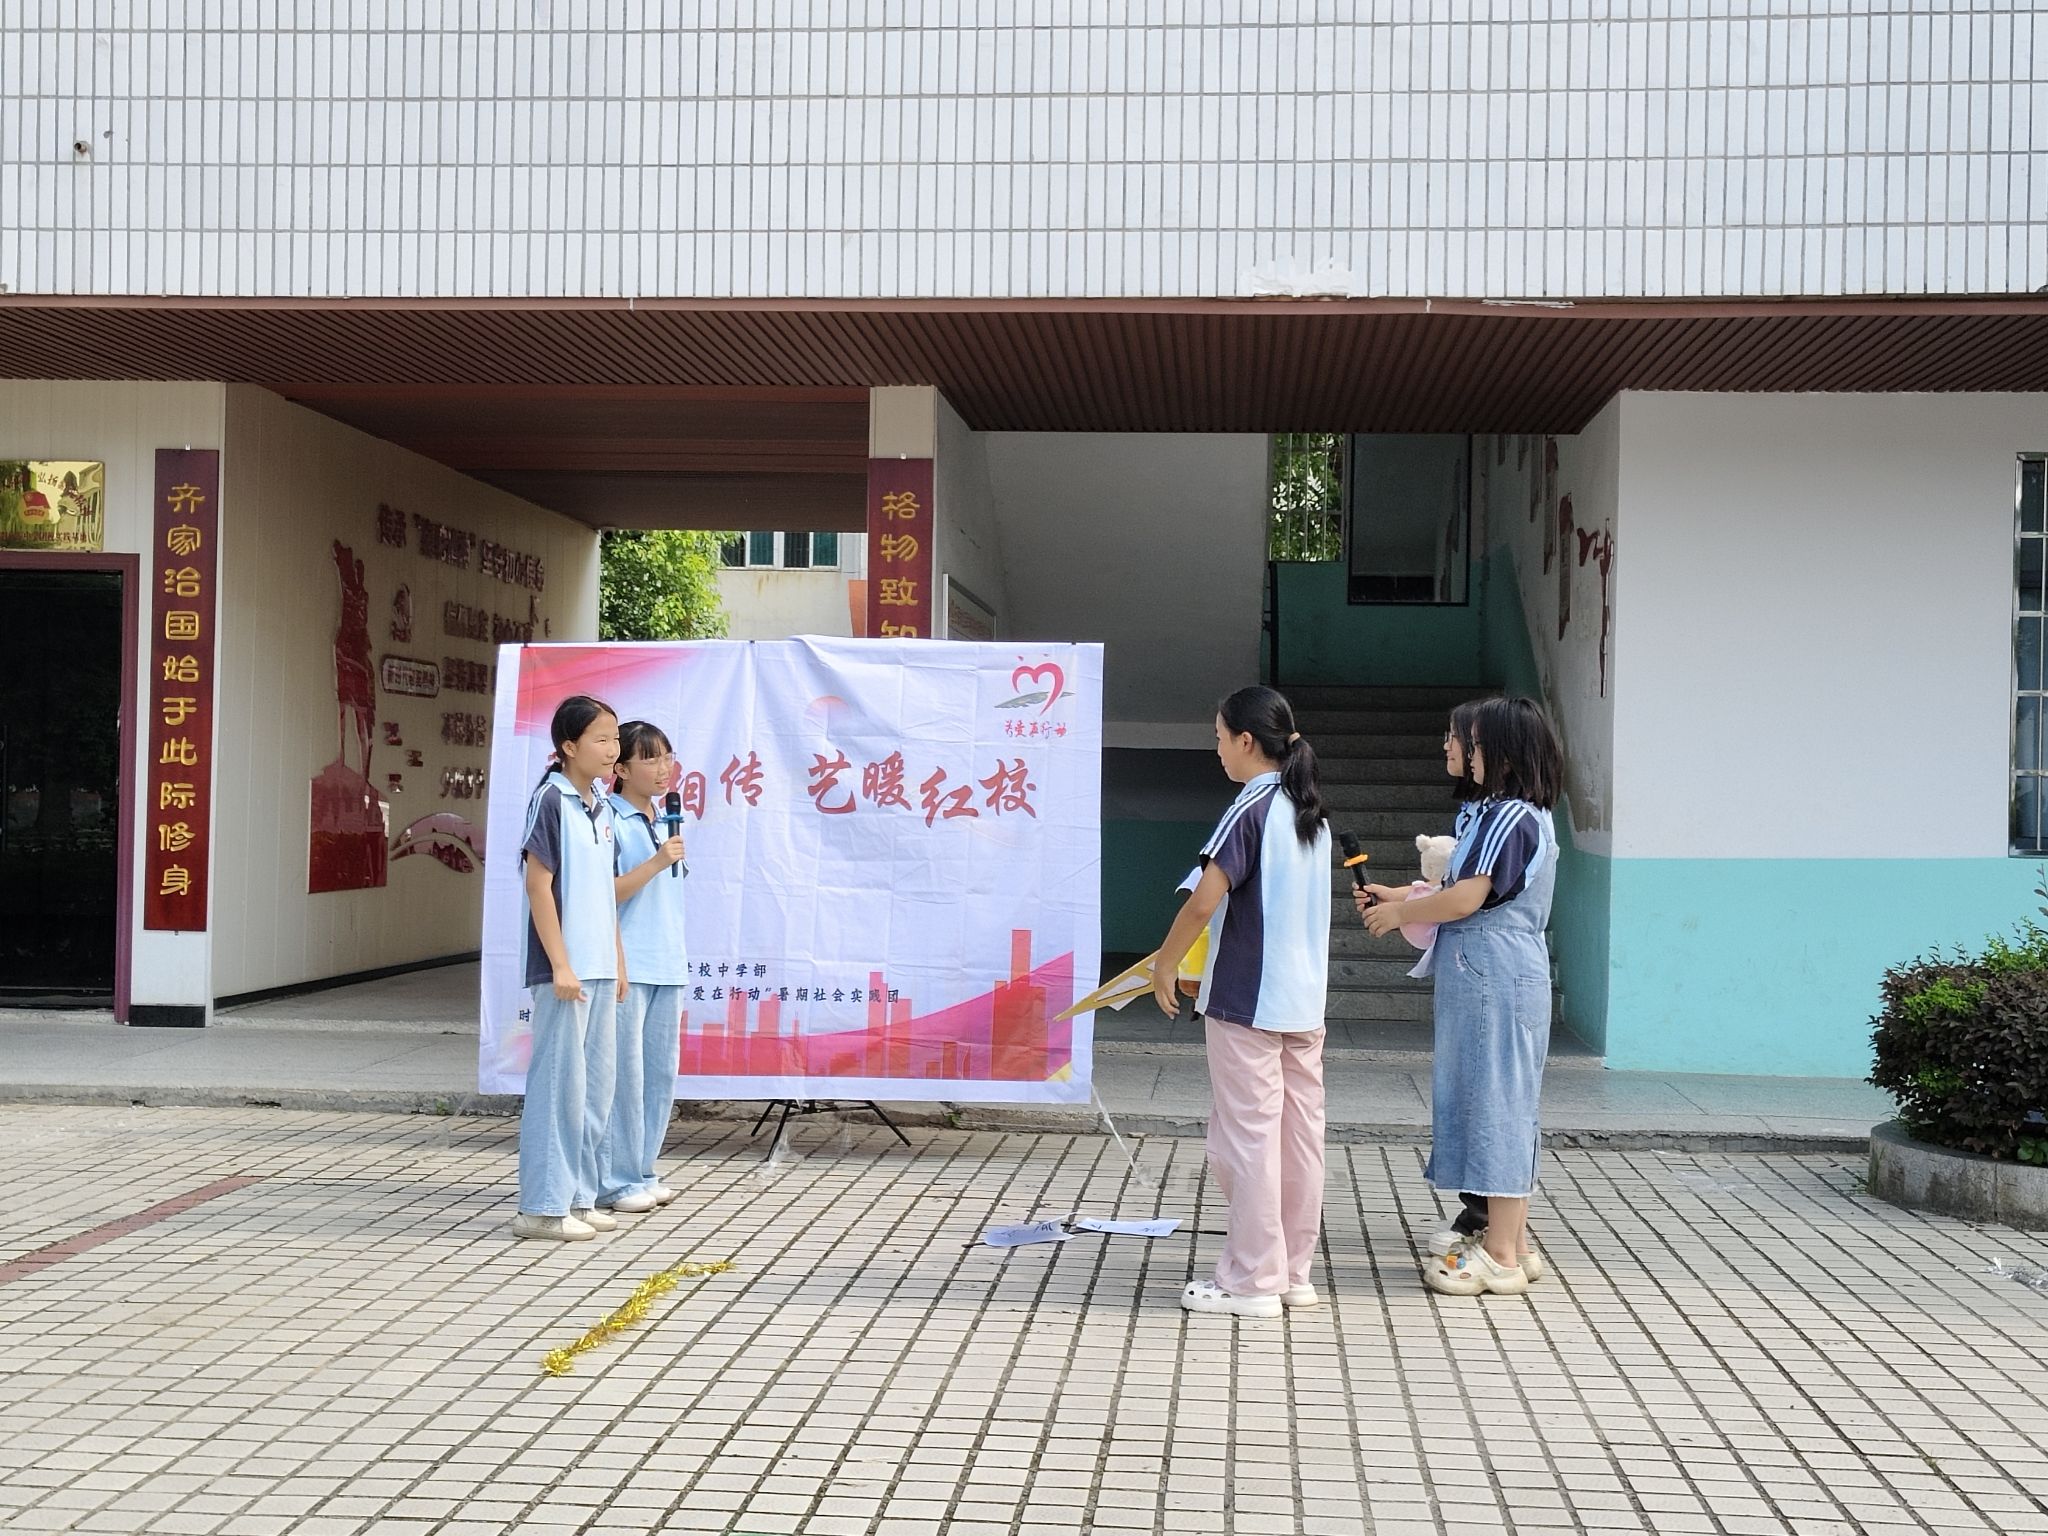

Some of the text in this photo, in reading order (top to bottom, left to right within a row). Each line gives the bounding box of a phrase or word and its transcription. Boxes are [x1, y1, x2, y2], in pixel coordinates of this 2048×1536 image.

[158, 482, 206, 896] 齐家治国始于此际修身
[602, 748, 1038, 829] 相传 艺暖红校
[519, 1008, 532, 1022] 时
